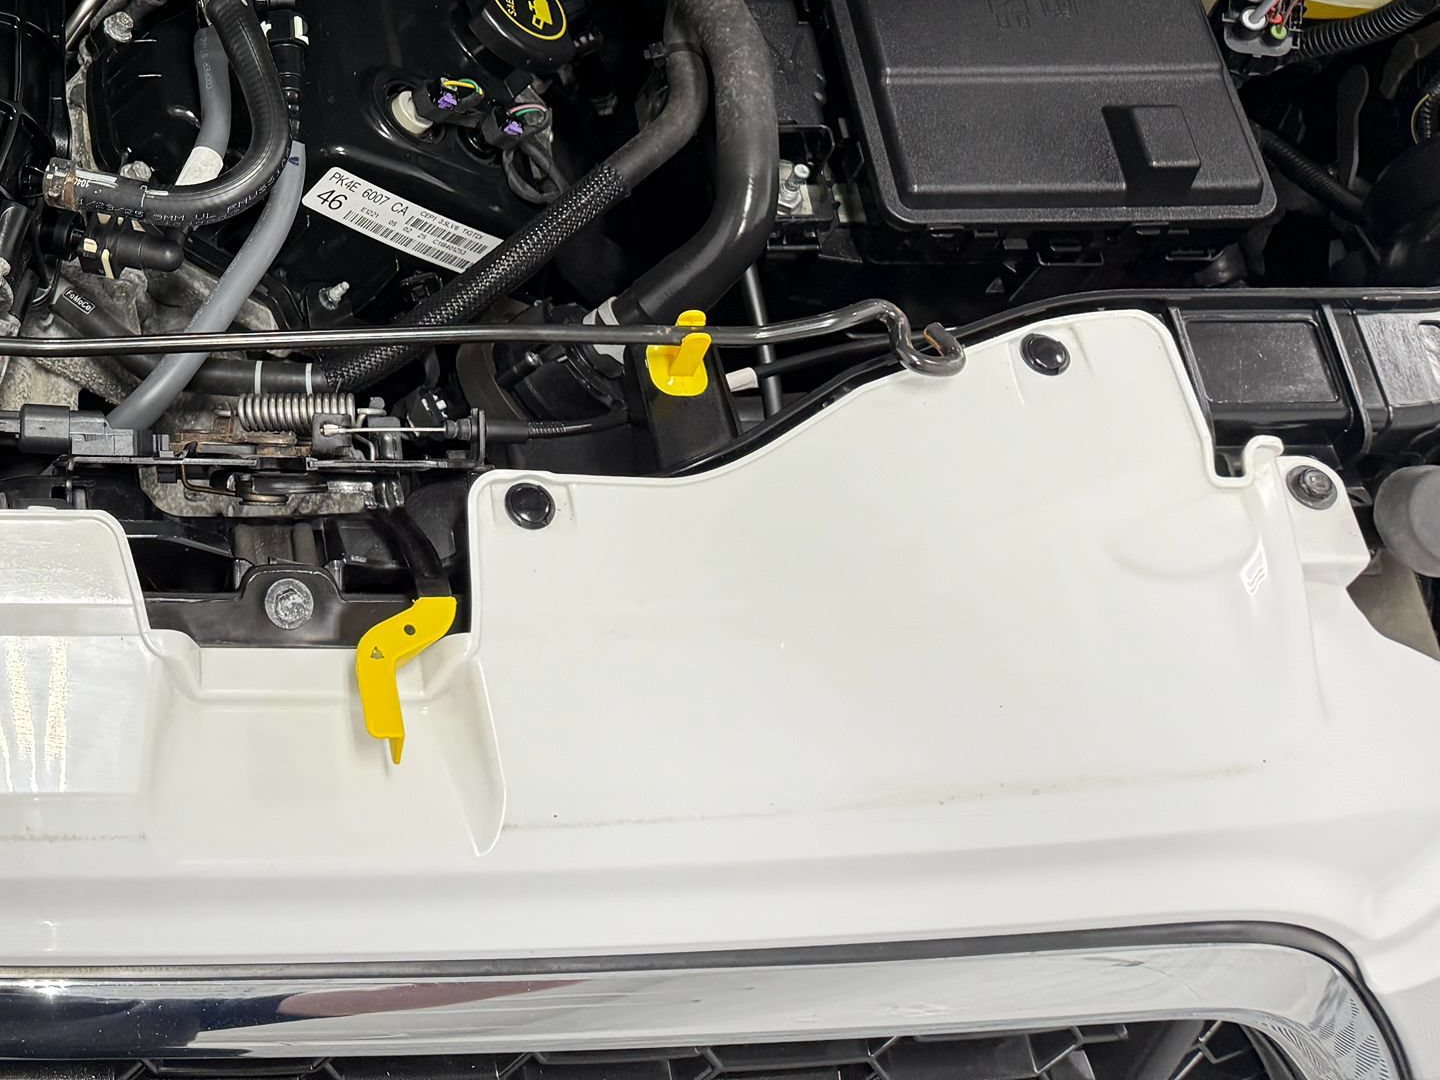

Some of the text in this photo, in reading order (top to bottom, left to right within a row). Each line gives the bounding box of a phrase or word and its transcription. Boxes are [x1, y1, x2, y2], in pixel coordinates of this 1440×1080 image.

[316, 189, 348, 210] 46
[329, 171, 361, 193] PK4E
[361, 188, 390, 206] 6007
[391, 202, 409, 217] CA
[65, 289, 92, 310] FoMoCo
